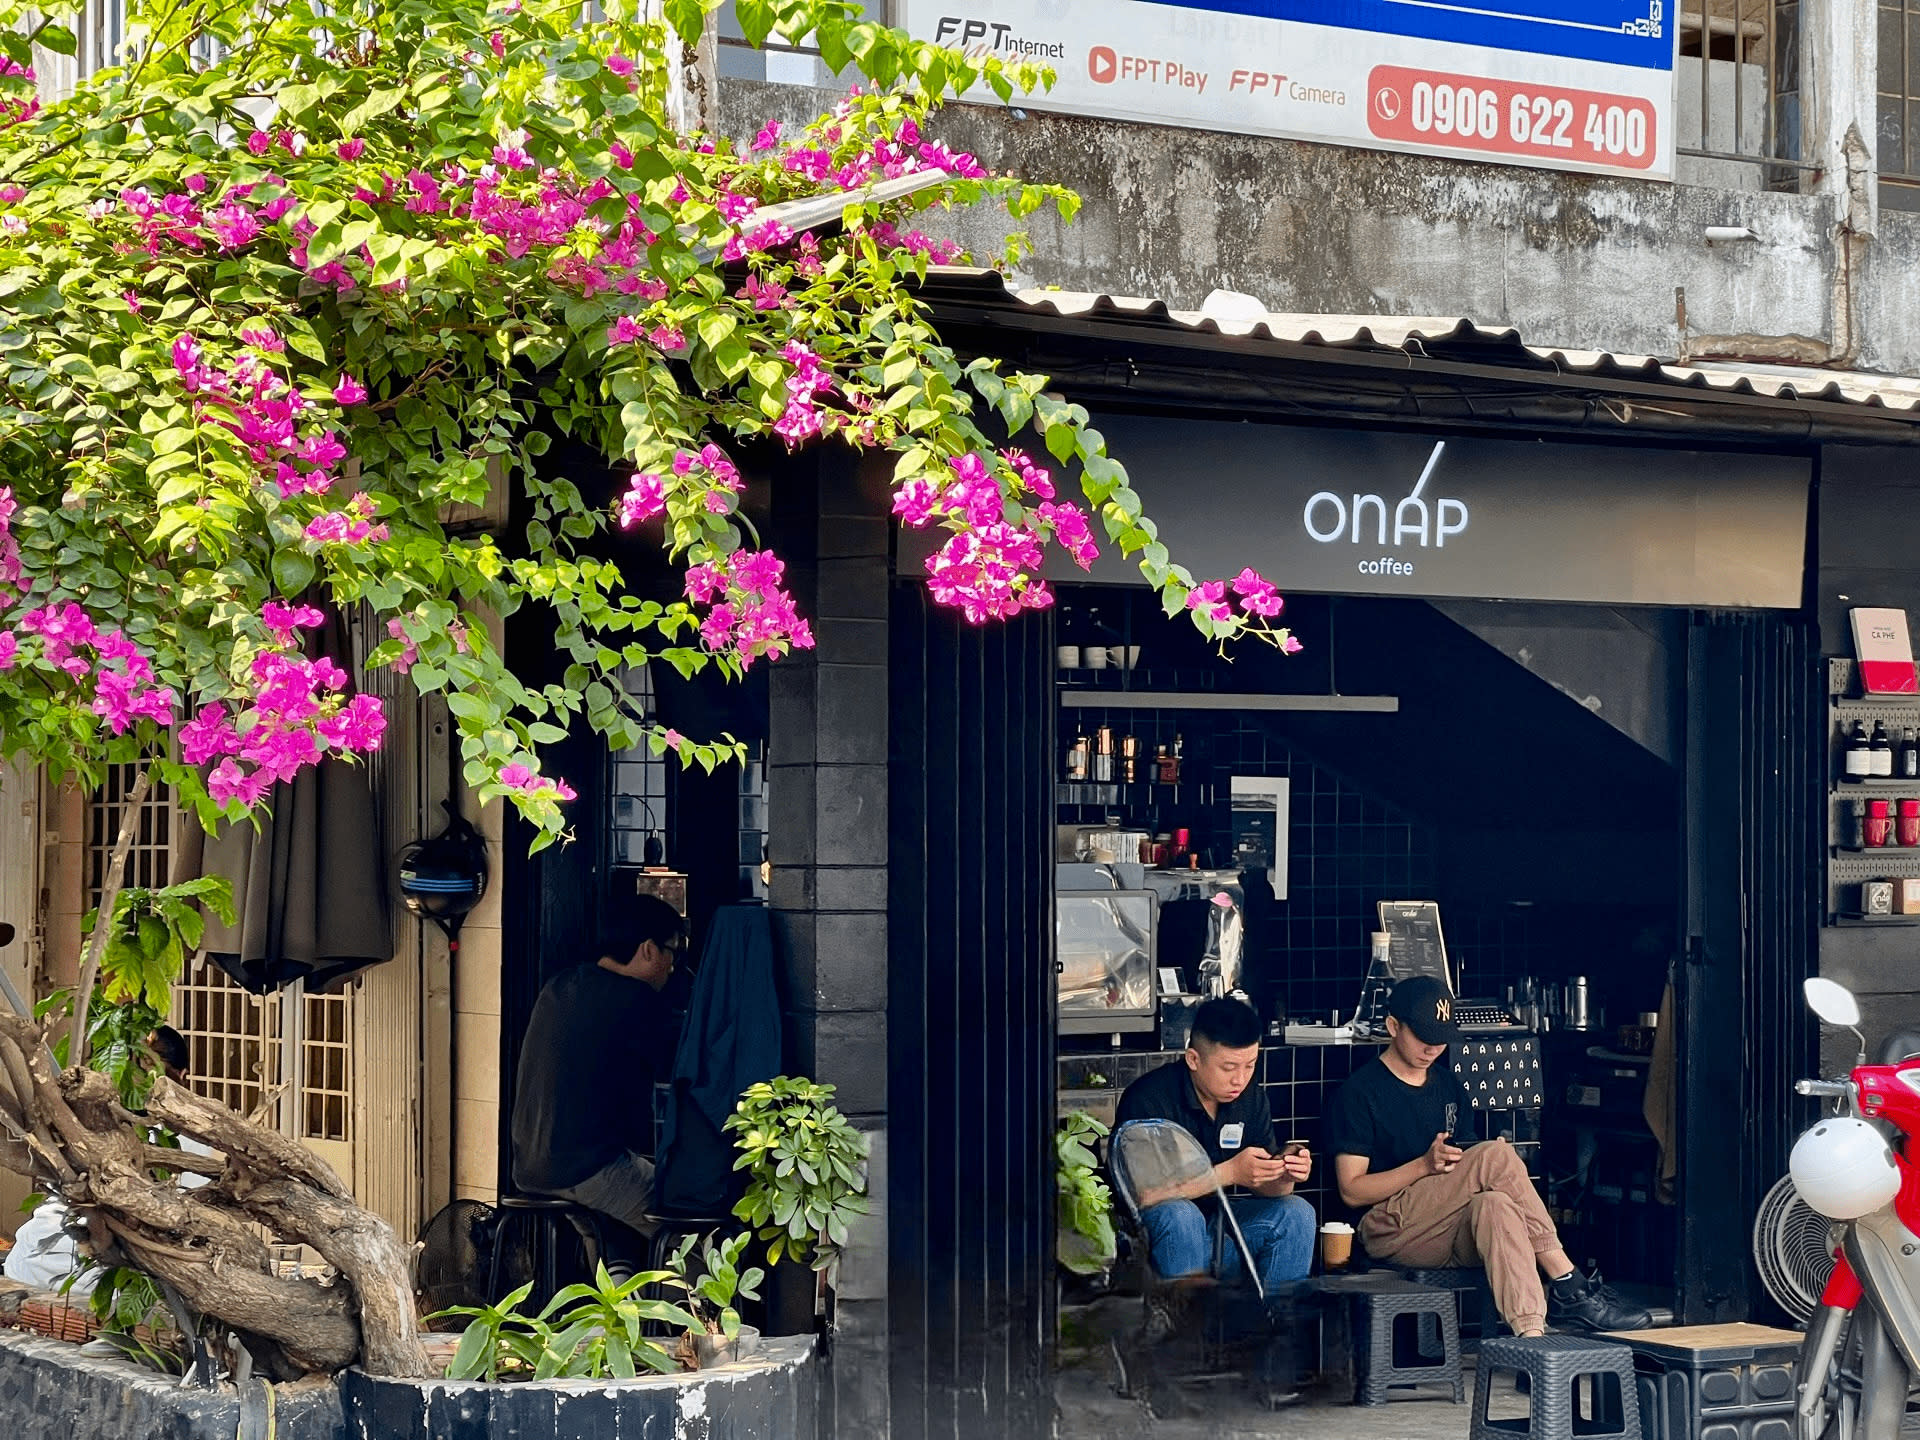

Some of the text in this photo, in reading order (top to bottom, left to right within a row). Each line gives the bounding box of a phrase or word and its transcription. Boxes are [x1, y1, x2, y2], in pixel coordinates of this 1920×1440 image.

[935, 17, 1011, 50] FPT
[1005, 35, 1064, 58] Internet
[1121, 56, 1208, 94] FPT Play
[1229, 70, 1345, 105] FPT Camera
[1412, 81, 1645, 157] 0906 622 400
[1358, 557, 1413, 575] coffee
[1436, 999, 1450, 1021] NY
